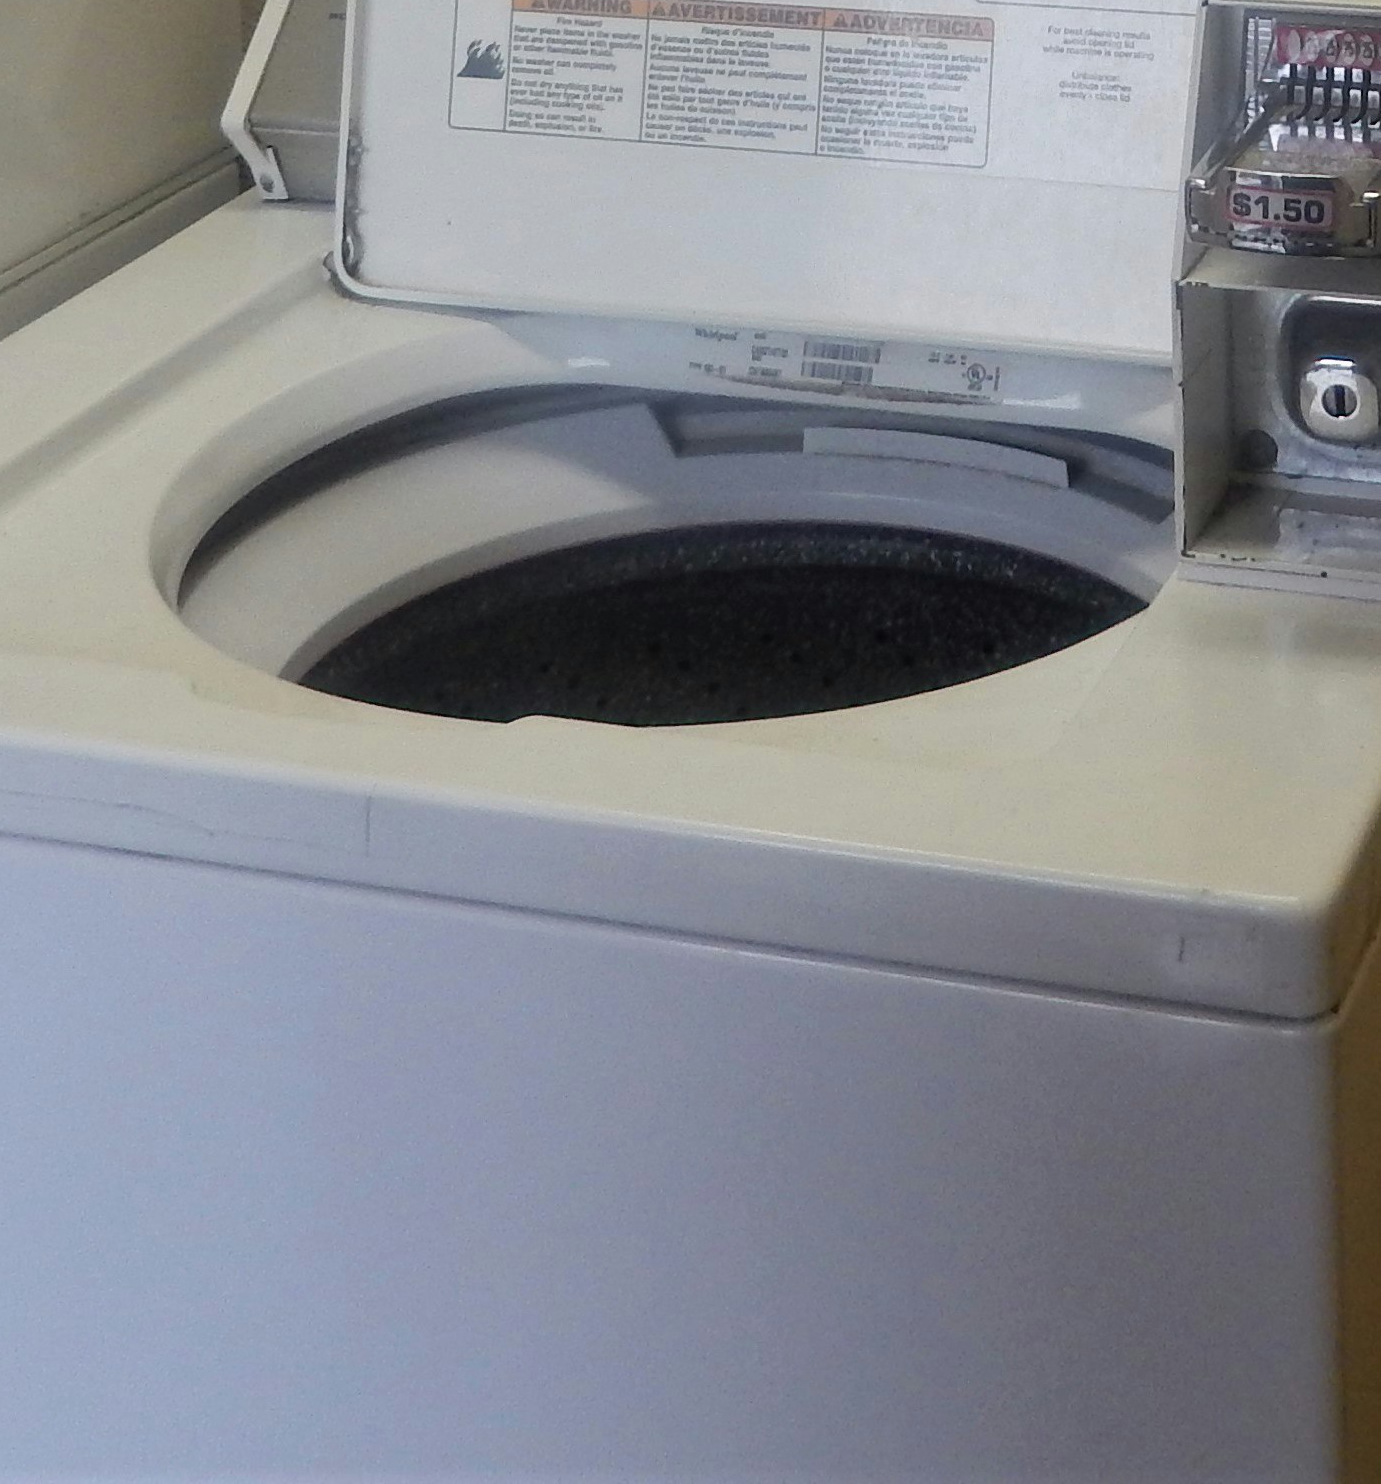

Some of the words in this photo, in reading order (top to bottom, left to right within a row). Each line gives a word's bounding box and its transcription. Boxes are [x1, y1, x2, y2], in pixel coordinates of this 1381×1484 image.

[668, 2, 821, 26] AVERTISSEMENT
[850, 14, 983, 36] ADVERTENCIA
[1231, 192, 1325, 225] $1.50
